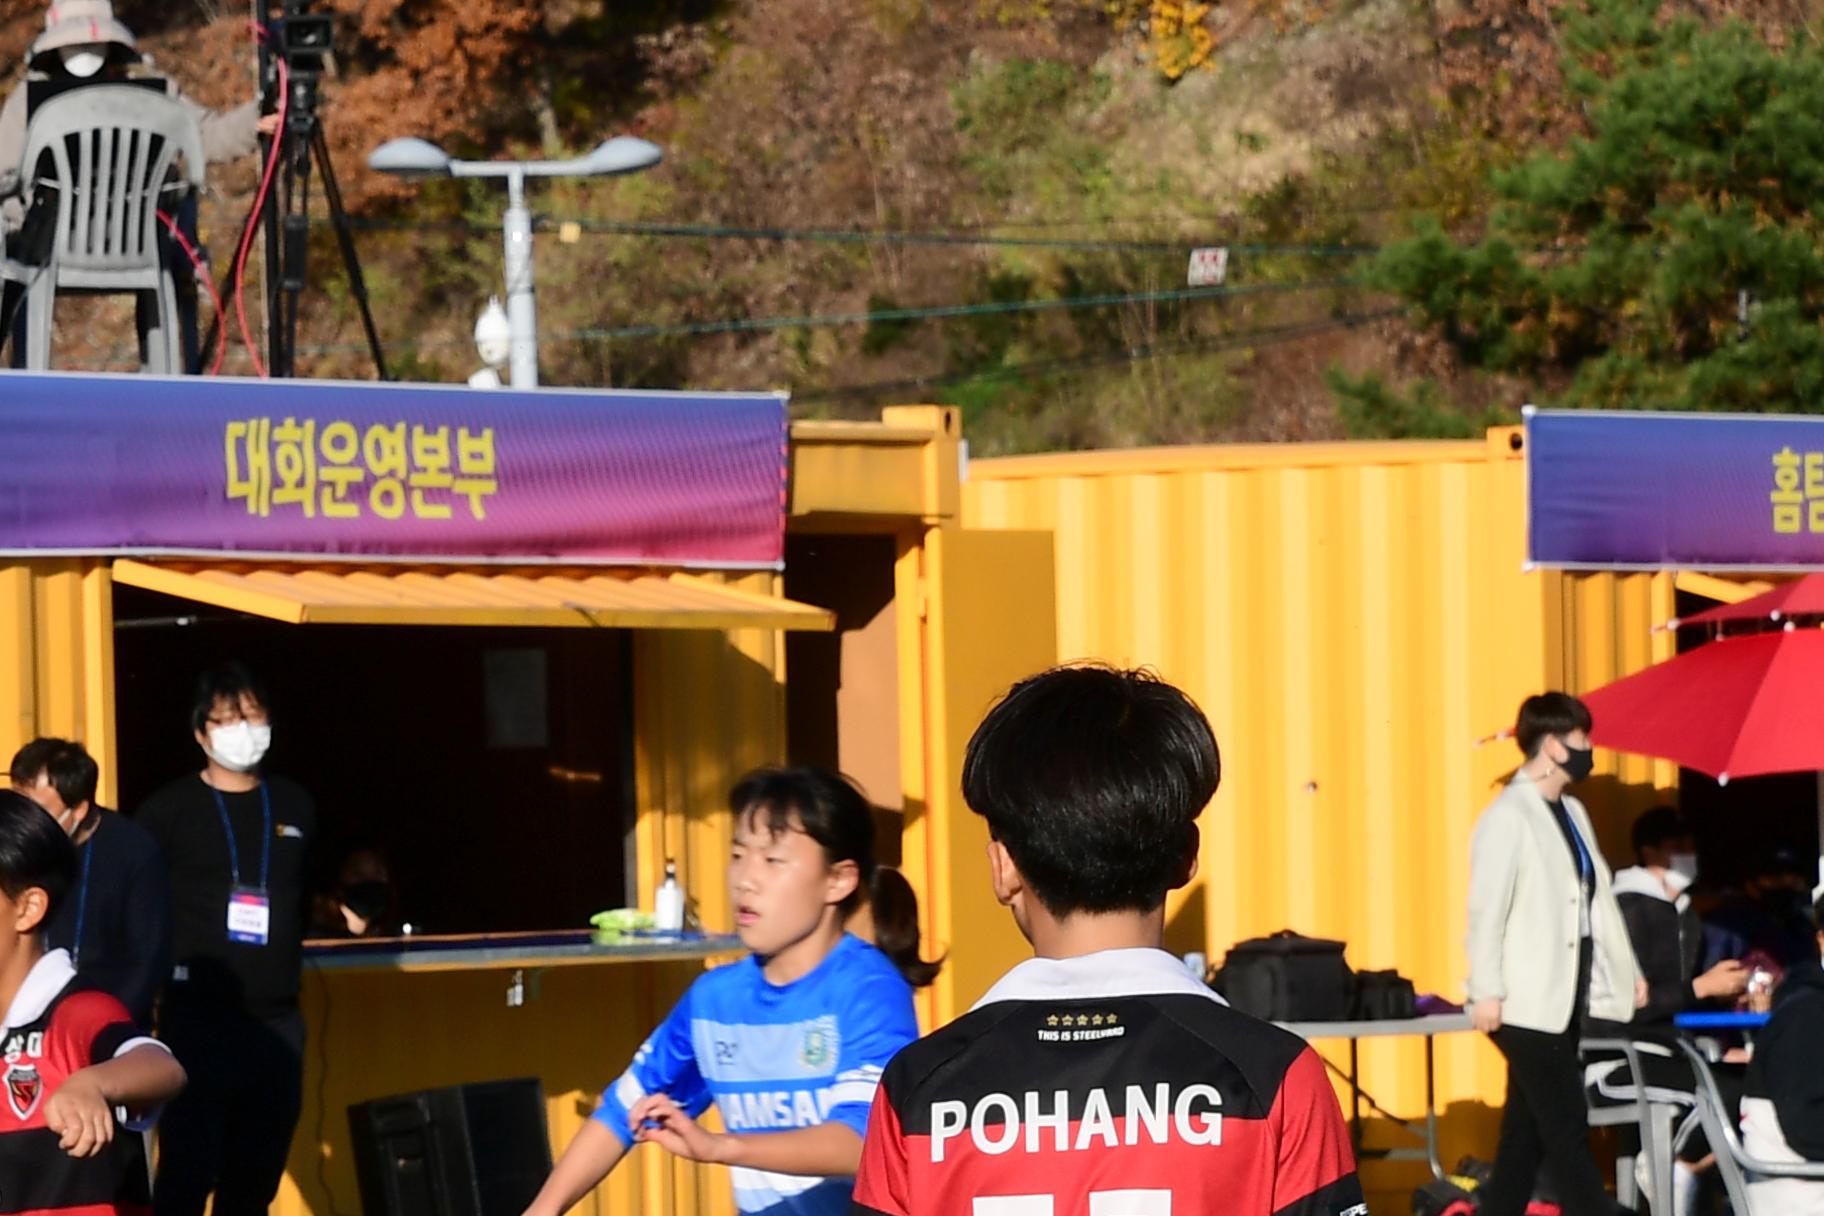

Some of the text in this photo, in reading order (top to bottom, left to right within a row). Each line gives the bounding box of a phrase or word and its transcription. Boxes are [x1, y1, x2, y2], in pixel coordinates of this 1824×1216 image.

[226, 417, 497, 520] 대회운영본부
[1038, 1029, 1059, 1042] THIS
[1061, 1030, 1072, 1042] IS
[931, 1082, 1223, 1163] POHANG
